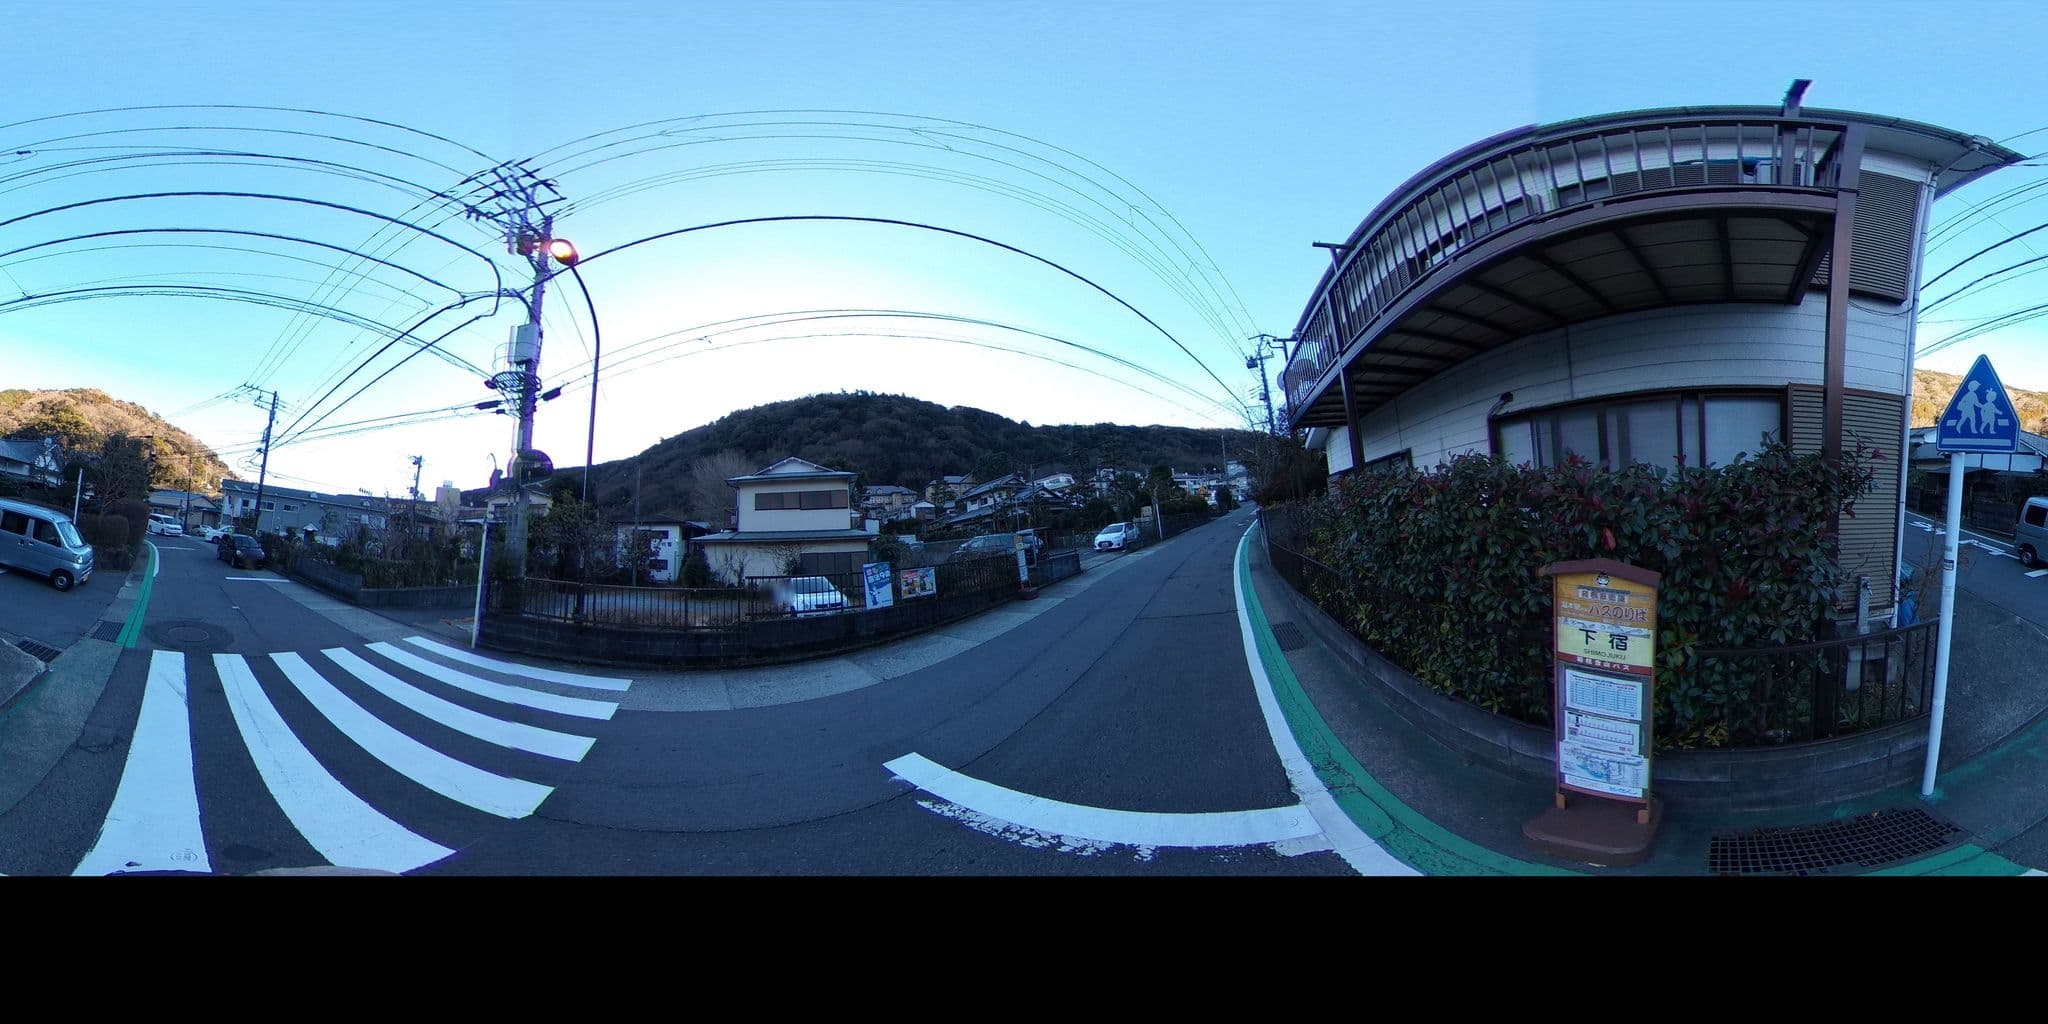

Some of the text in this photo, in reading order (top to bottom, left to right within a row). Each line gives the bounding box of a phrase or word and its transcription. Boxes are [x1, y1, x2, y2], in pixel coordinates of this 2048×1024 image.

[1588, 603, 1648, 622] バスのりば
[1579, 629, 1628, 651] 下宿
[1584, 648, 1626, 660] SHIMOJUKU
